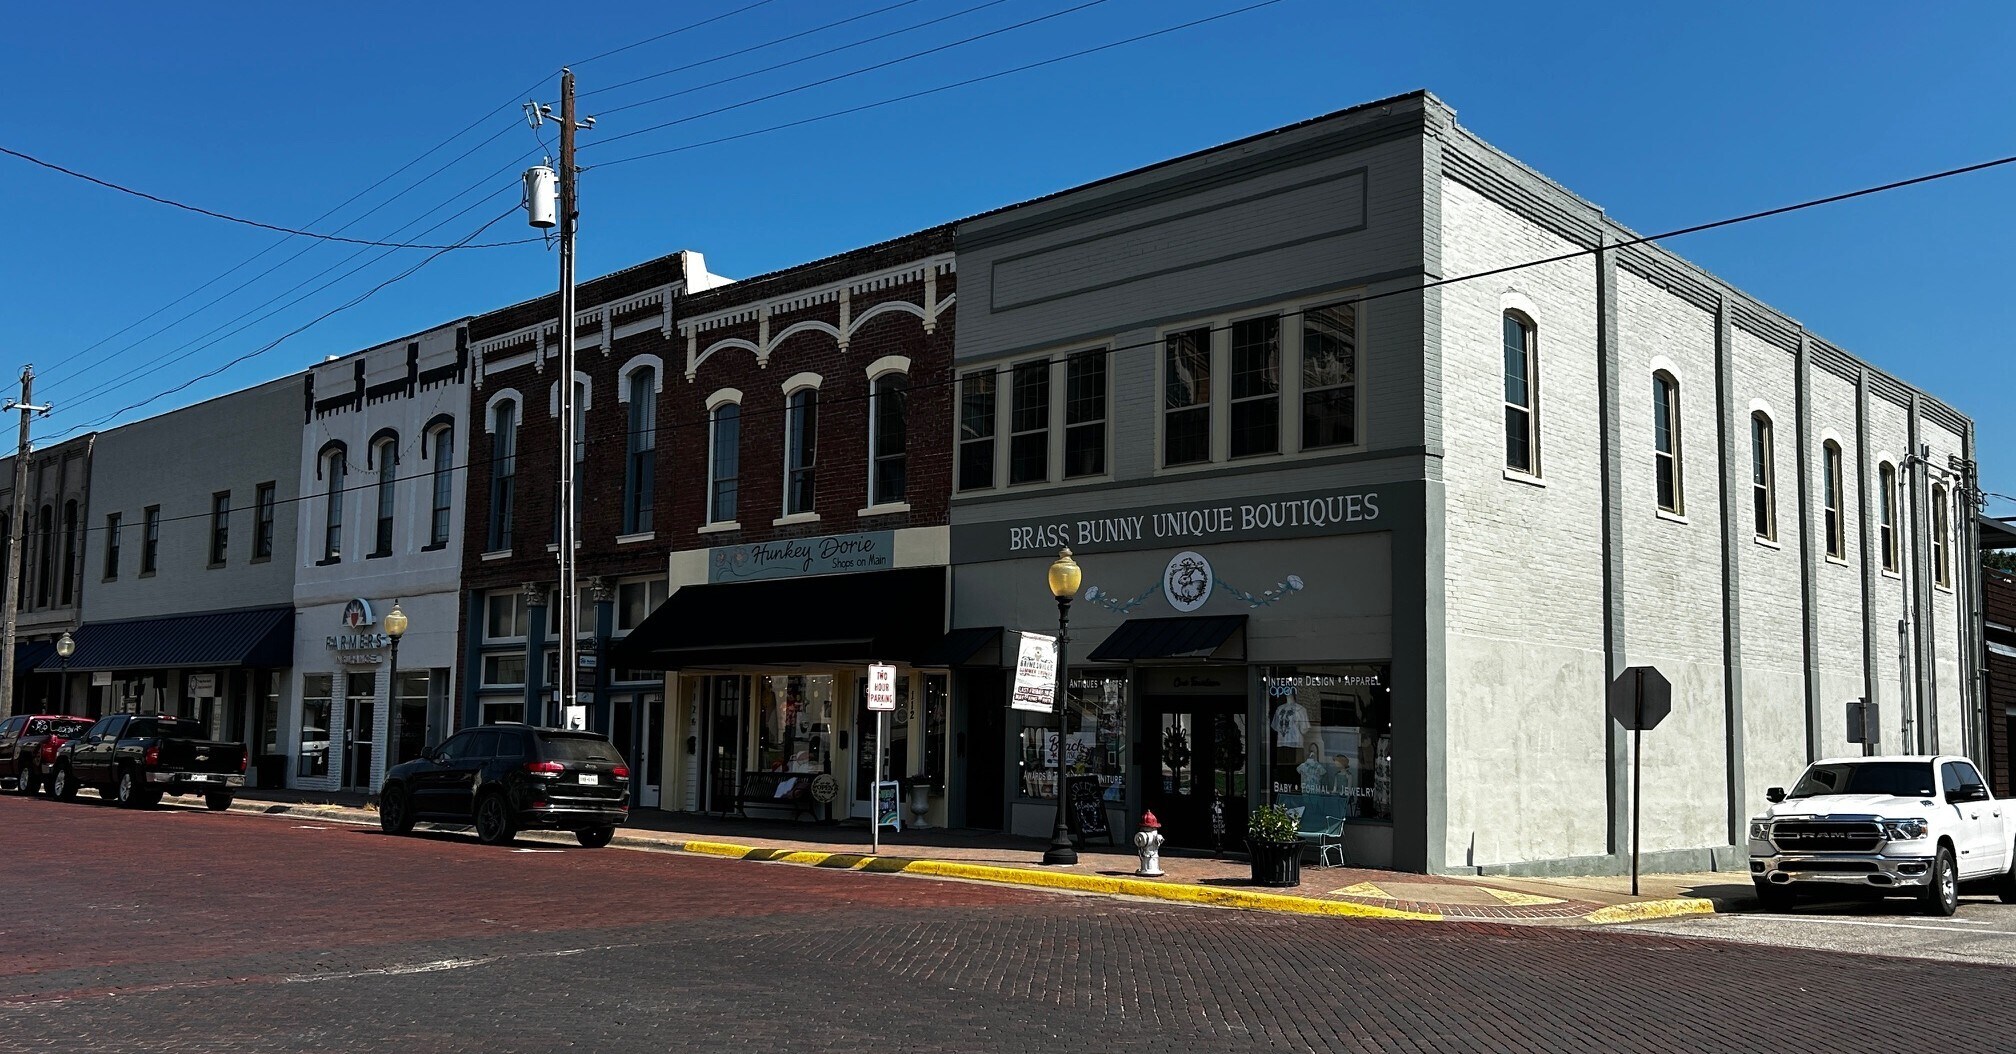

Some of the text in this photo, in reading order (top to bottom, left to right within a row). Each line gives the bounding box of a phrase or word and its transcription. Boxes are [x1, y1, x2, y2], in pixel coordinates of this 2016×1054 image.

[1009, 493, 1379, 551] BRASS BUNNY UNIQUE BOUTIQUES
[752, 536, 876, 572] Hunkey Dorie
[832, 554, 887, 571] Shops on Main
[325, 634, 386, 650] FARMERS
[877, 671, 888, 681] TWO
[1268, 676, 1381, 687] INTERIOR DESIGN APPAREL
[874, 683, 889, 692] HOUR
[1269, 686, 1298, 698] open
[870, 694, 893, 703] PARKING
[1273, 781, 1376, 798] BABY FORMAL JEWELRY
